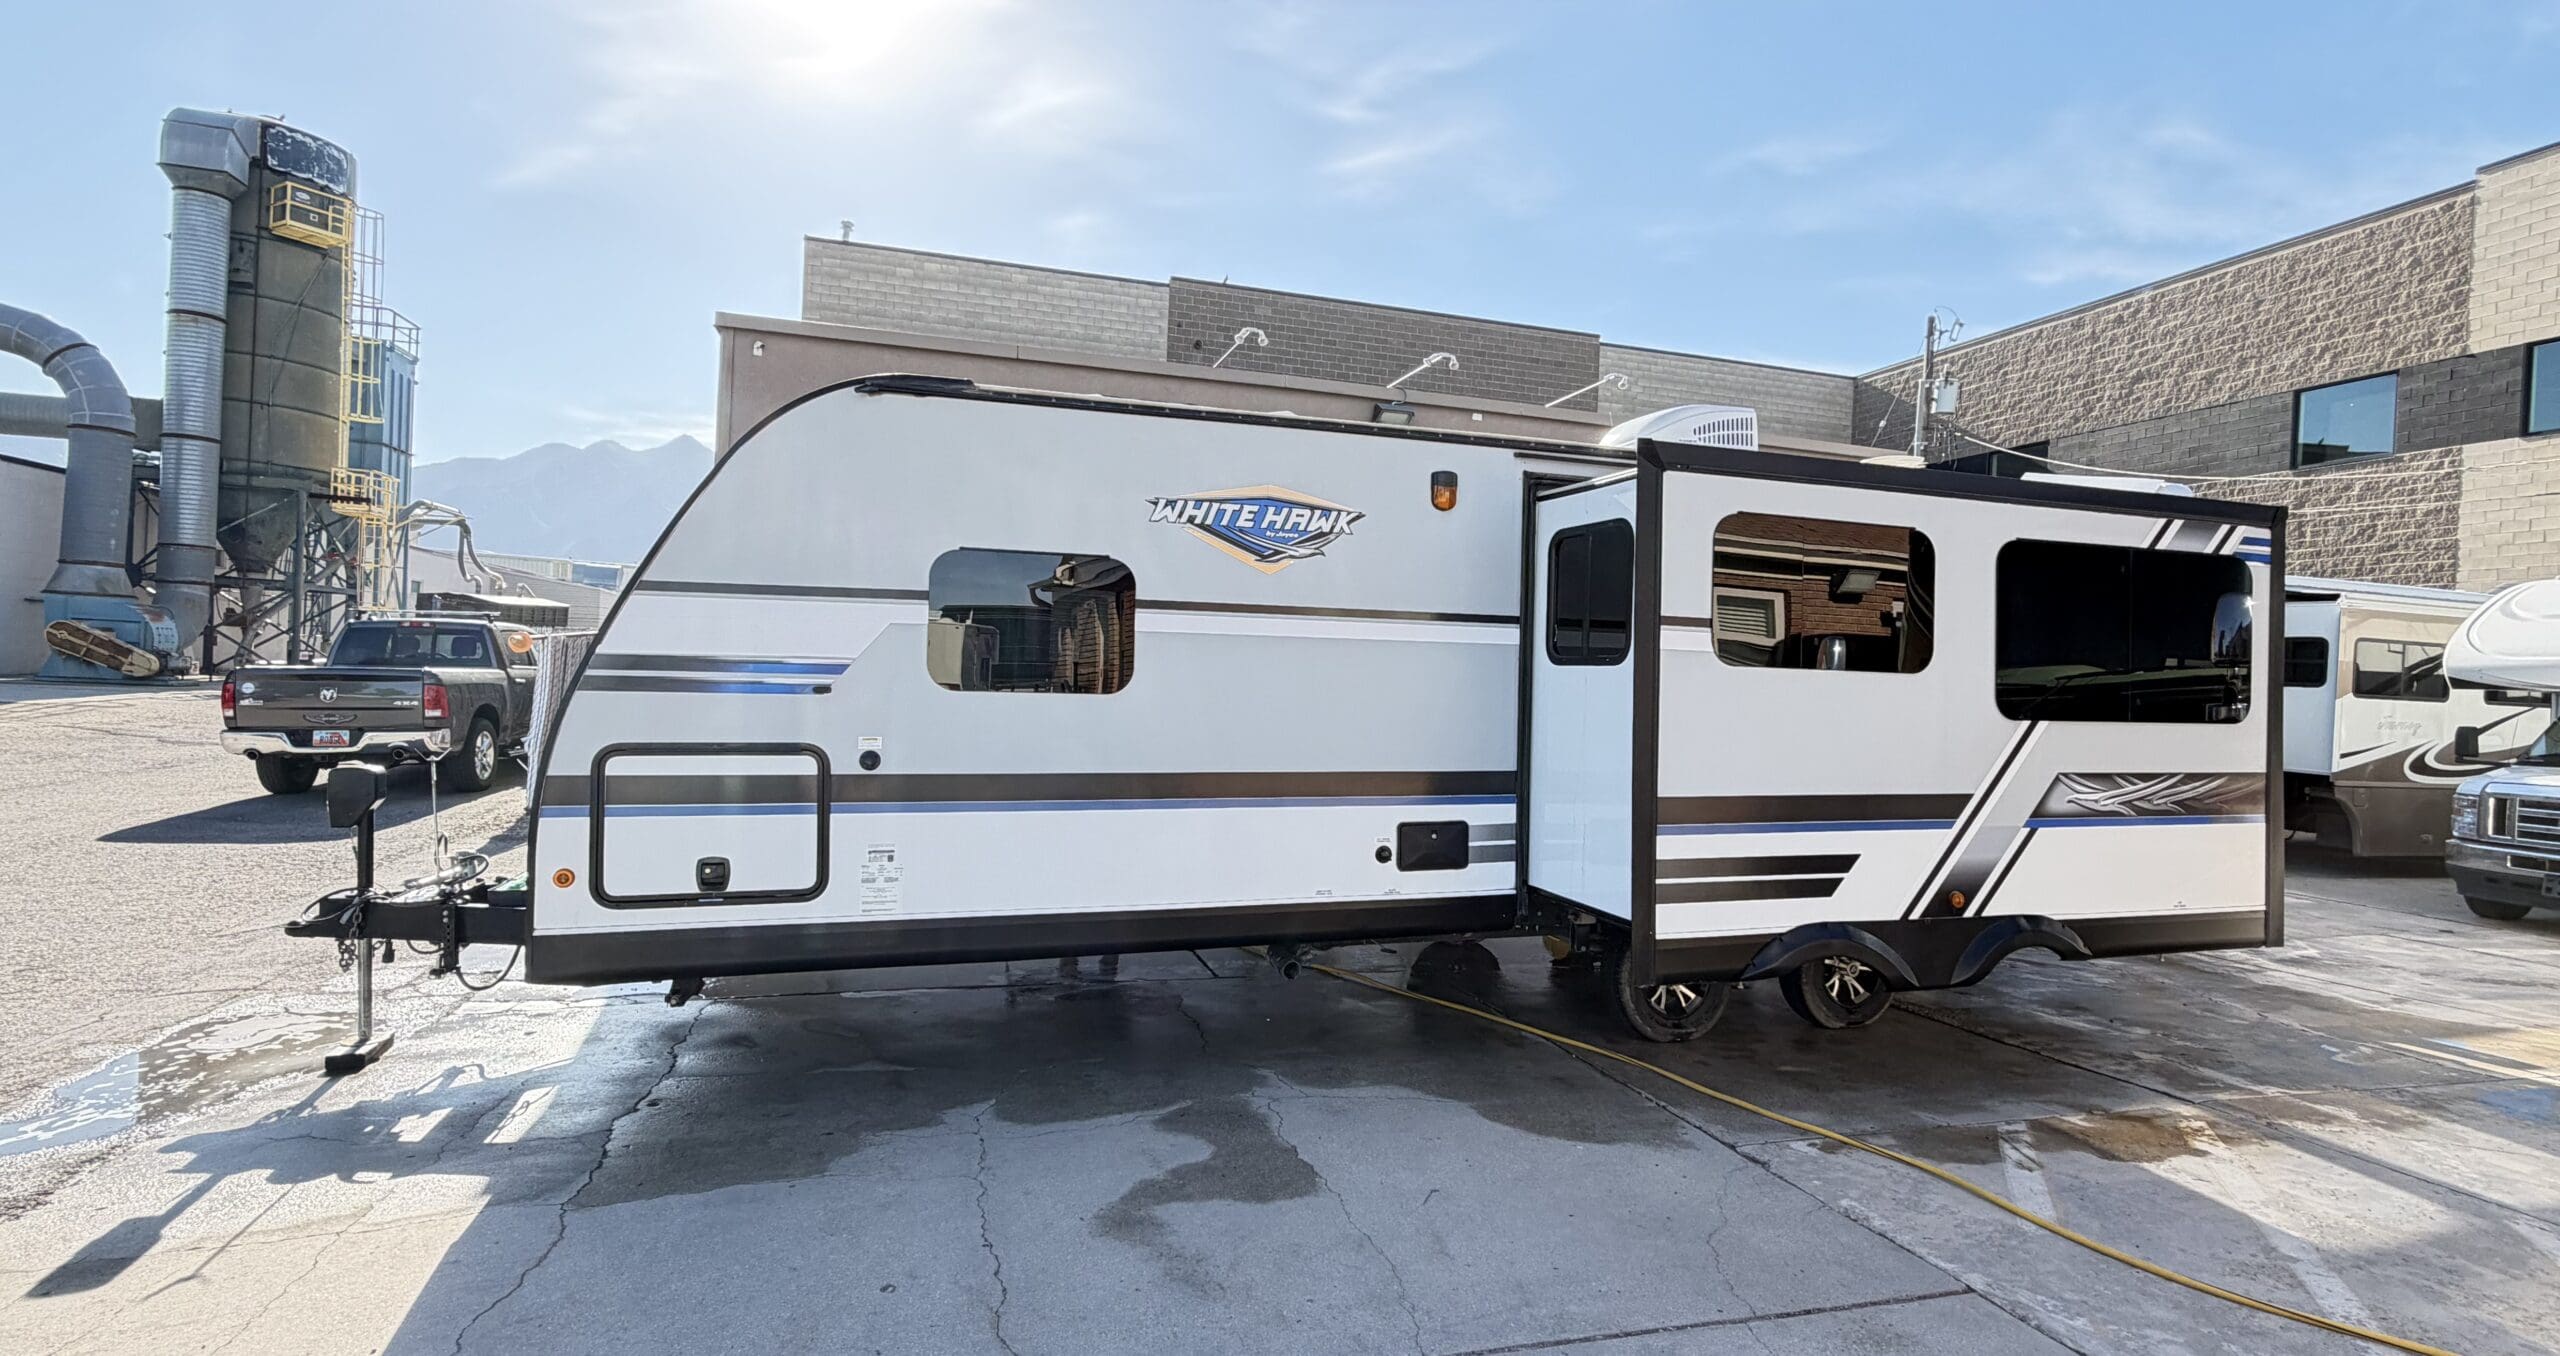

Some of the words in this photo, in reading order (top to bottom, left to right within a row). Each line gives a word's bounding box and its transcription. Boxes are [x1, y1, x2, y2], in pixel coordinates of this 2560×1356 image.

[1149, 498, 1260, 528] WHITE
[1259, 505, 1359, 535] HAWK
[1265, 530, 1276, 538] by
